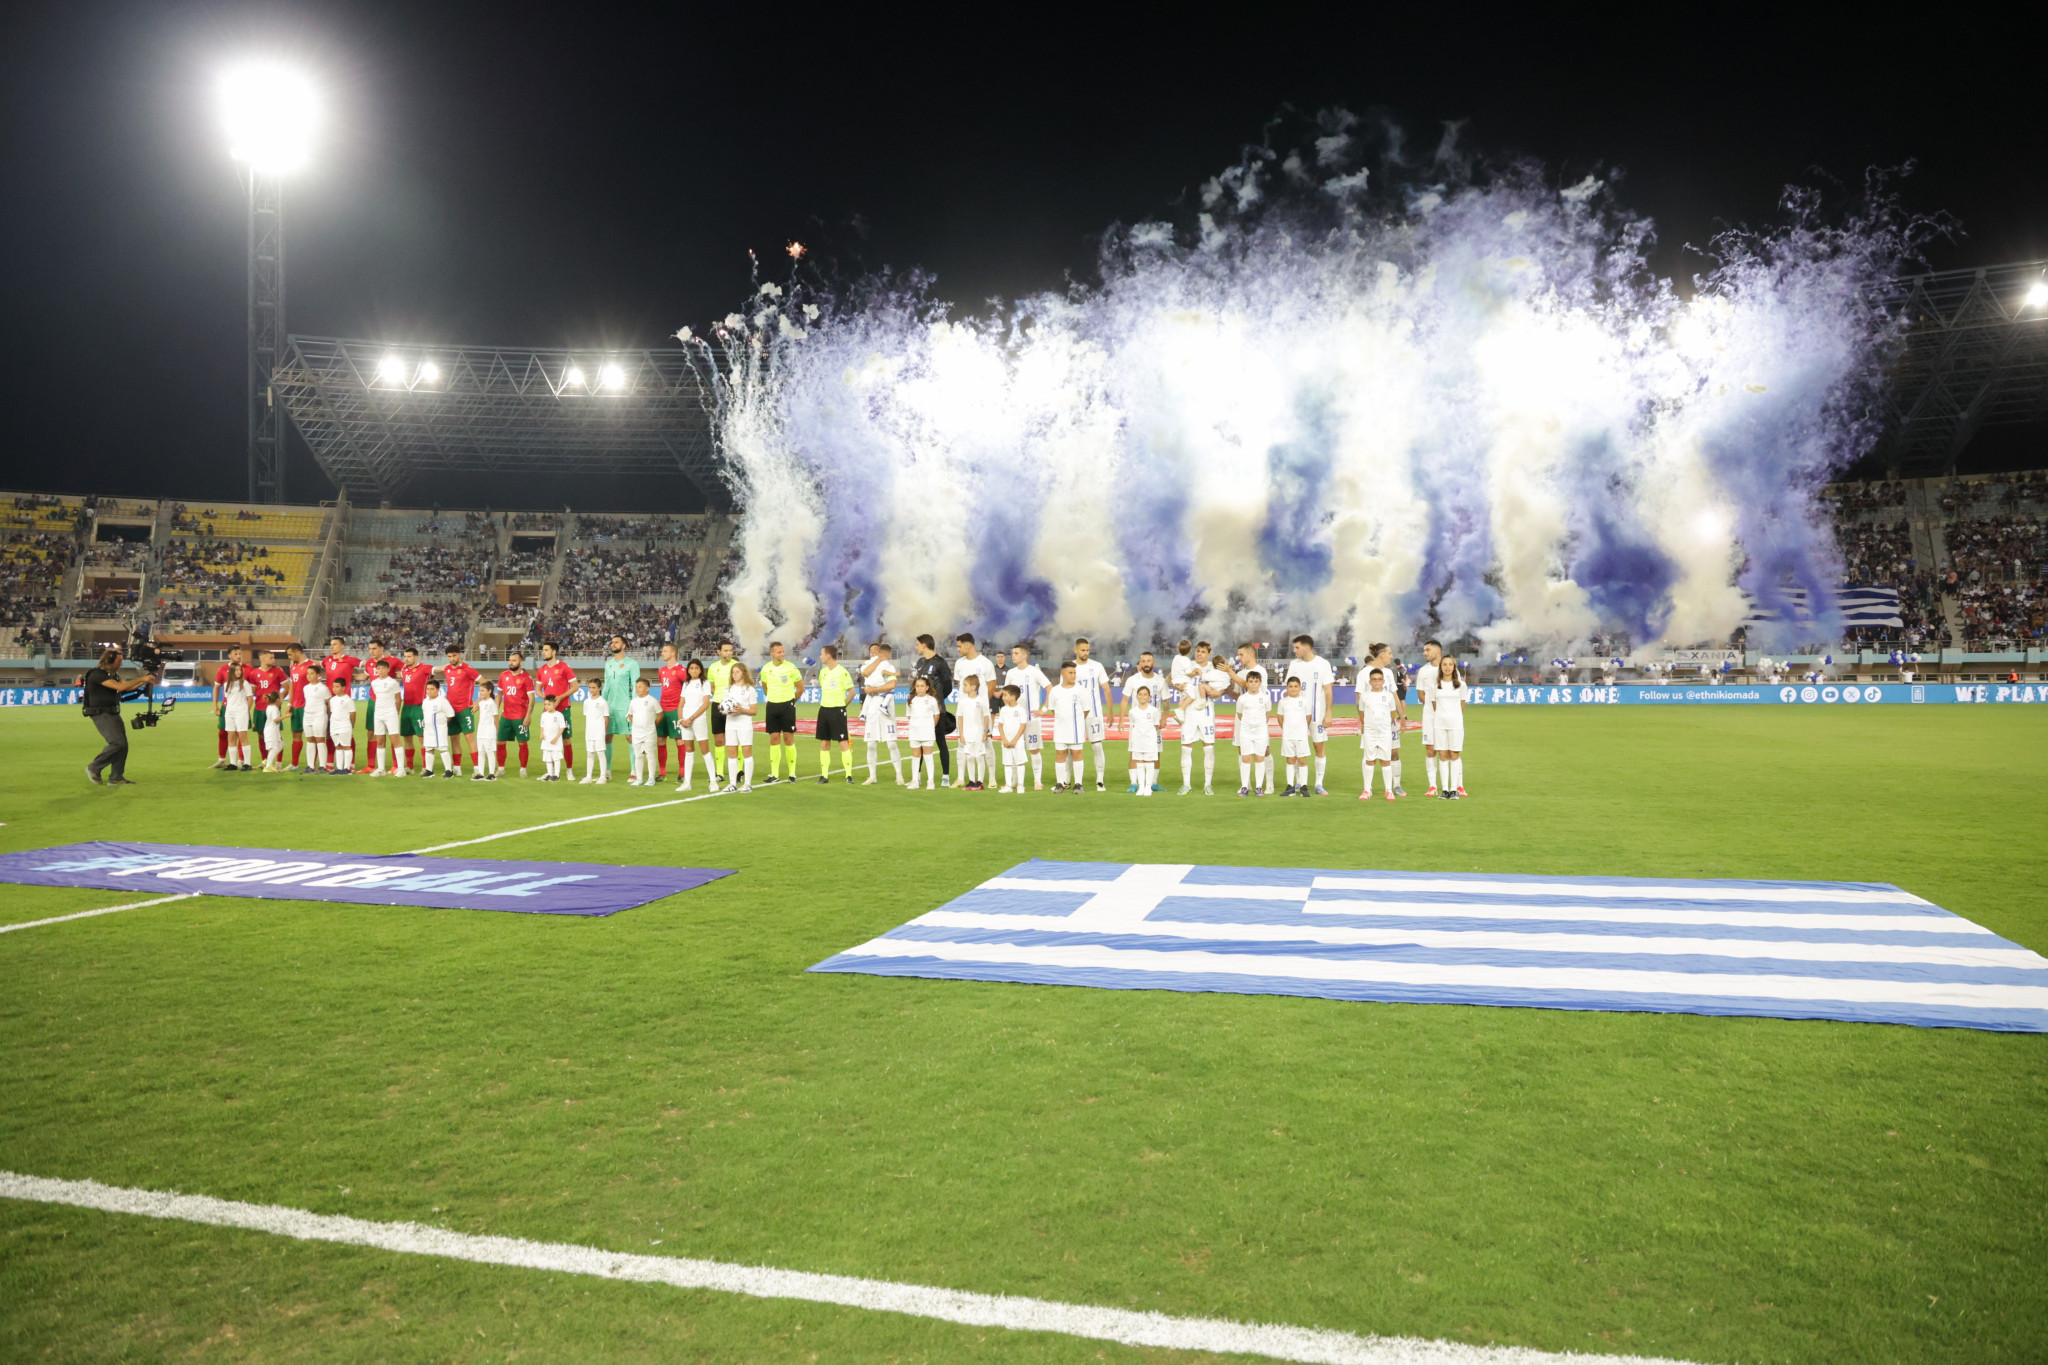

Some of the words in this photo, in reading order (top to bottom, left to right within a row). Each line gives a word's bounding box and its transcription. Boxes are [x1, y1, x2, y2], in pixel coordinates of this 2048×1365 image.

[331, 661, 338, 670] 8
[292, 673, 299, 682] 19
[449, 677, 455, 686] 3
[259, 680, 268, 688] 18
[548, 678, 553, 687] 4
[663, 678, 669, 688] 14
[166, 691, 212, 699] @ethnikiomada
[507, 686, 517, 695] 20
[1639, 690, 1670, 700] Follow
[1672, 692, 1683, 700] us
[1686, 690, 1760, 700] @ethnikiomada
[1955, 685, 1987, 703] WE
[1996, 685, 2048, 703] PLAY
[22, 689, 62, 705] PLAY
[1492, 687, 1541, 704] PLAY
[1549, 688, 1572, 704] AS
[1581, 687, 1620, 704] ONE
[465, 717, 472, 726] 3
[887, 725, 895, 734] 11
[1091, 724, 1100, 734] 17
[1204, 726, 1215, 735] 15
[1317, 725, 1323, 734] 8
[1028, 735, 1037, 743] 26
[29, 853, 600, 897] #FOOTBALL
